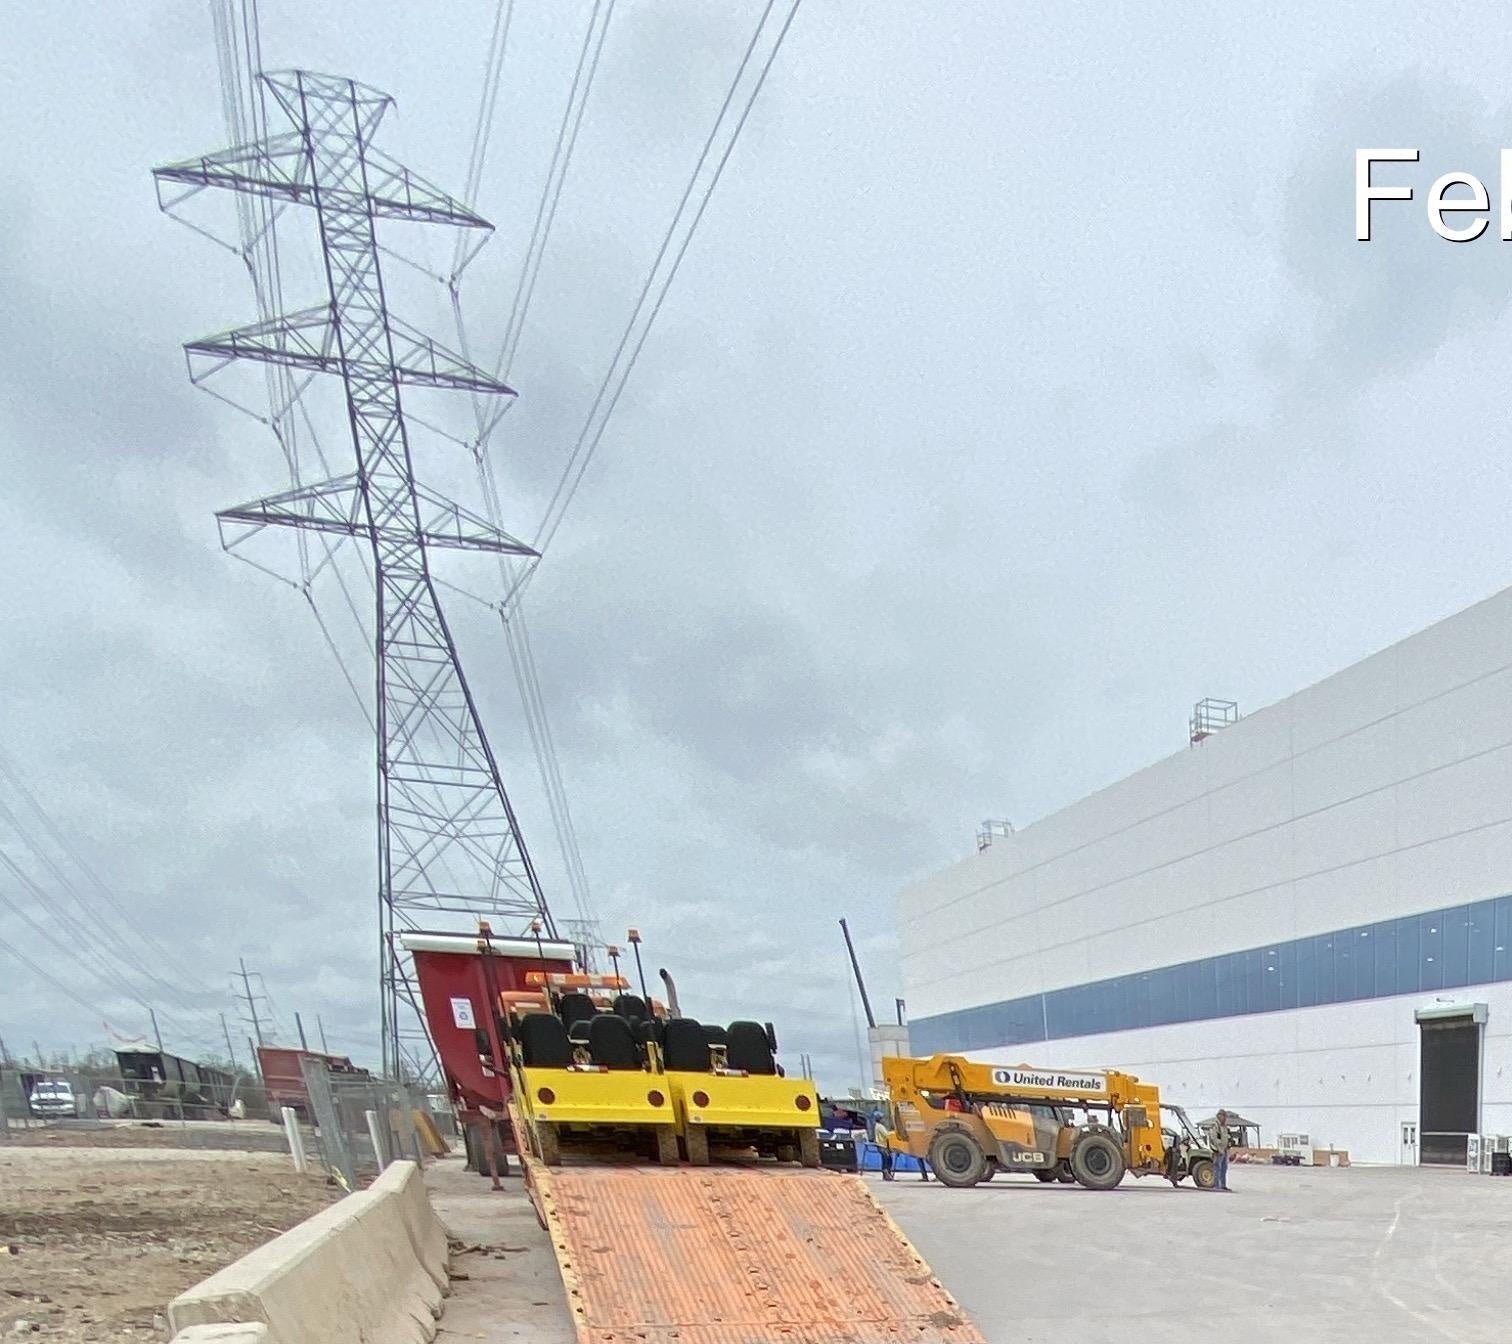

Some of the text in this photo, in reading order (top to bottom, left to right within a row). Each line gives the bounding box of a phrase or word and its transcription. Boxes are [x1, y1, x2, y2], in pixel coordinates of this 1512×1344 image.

[1013, 1072, 1102, 1090] United Rentals
[1012, 1151, 1045, 1163] JCB
